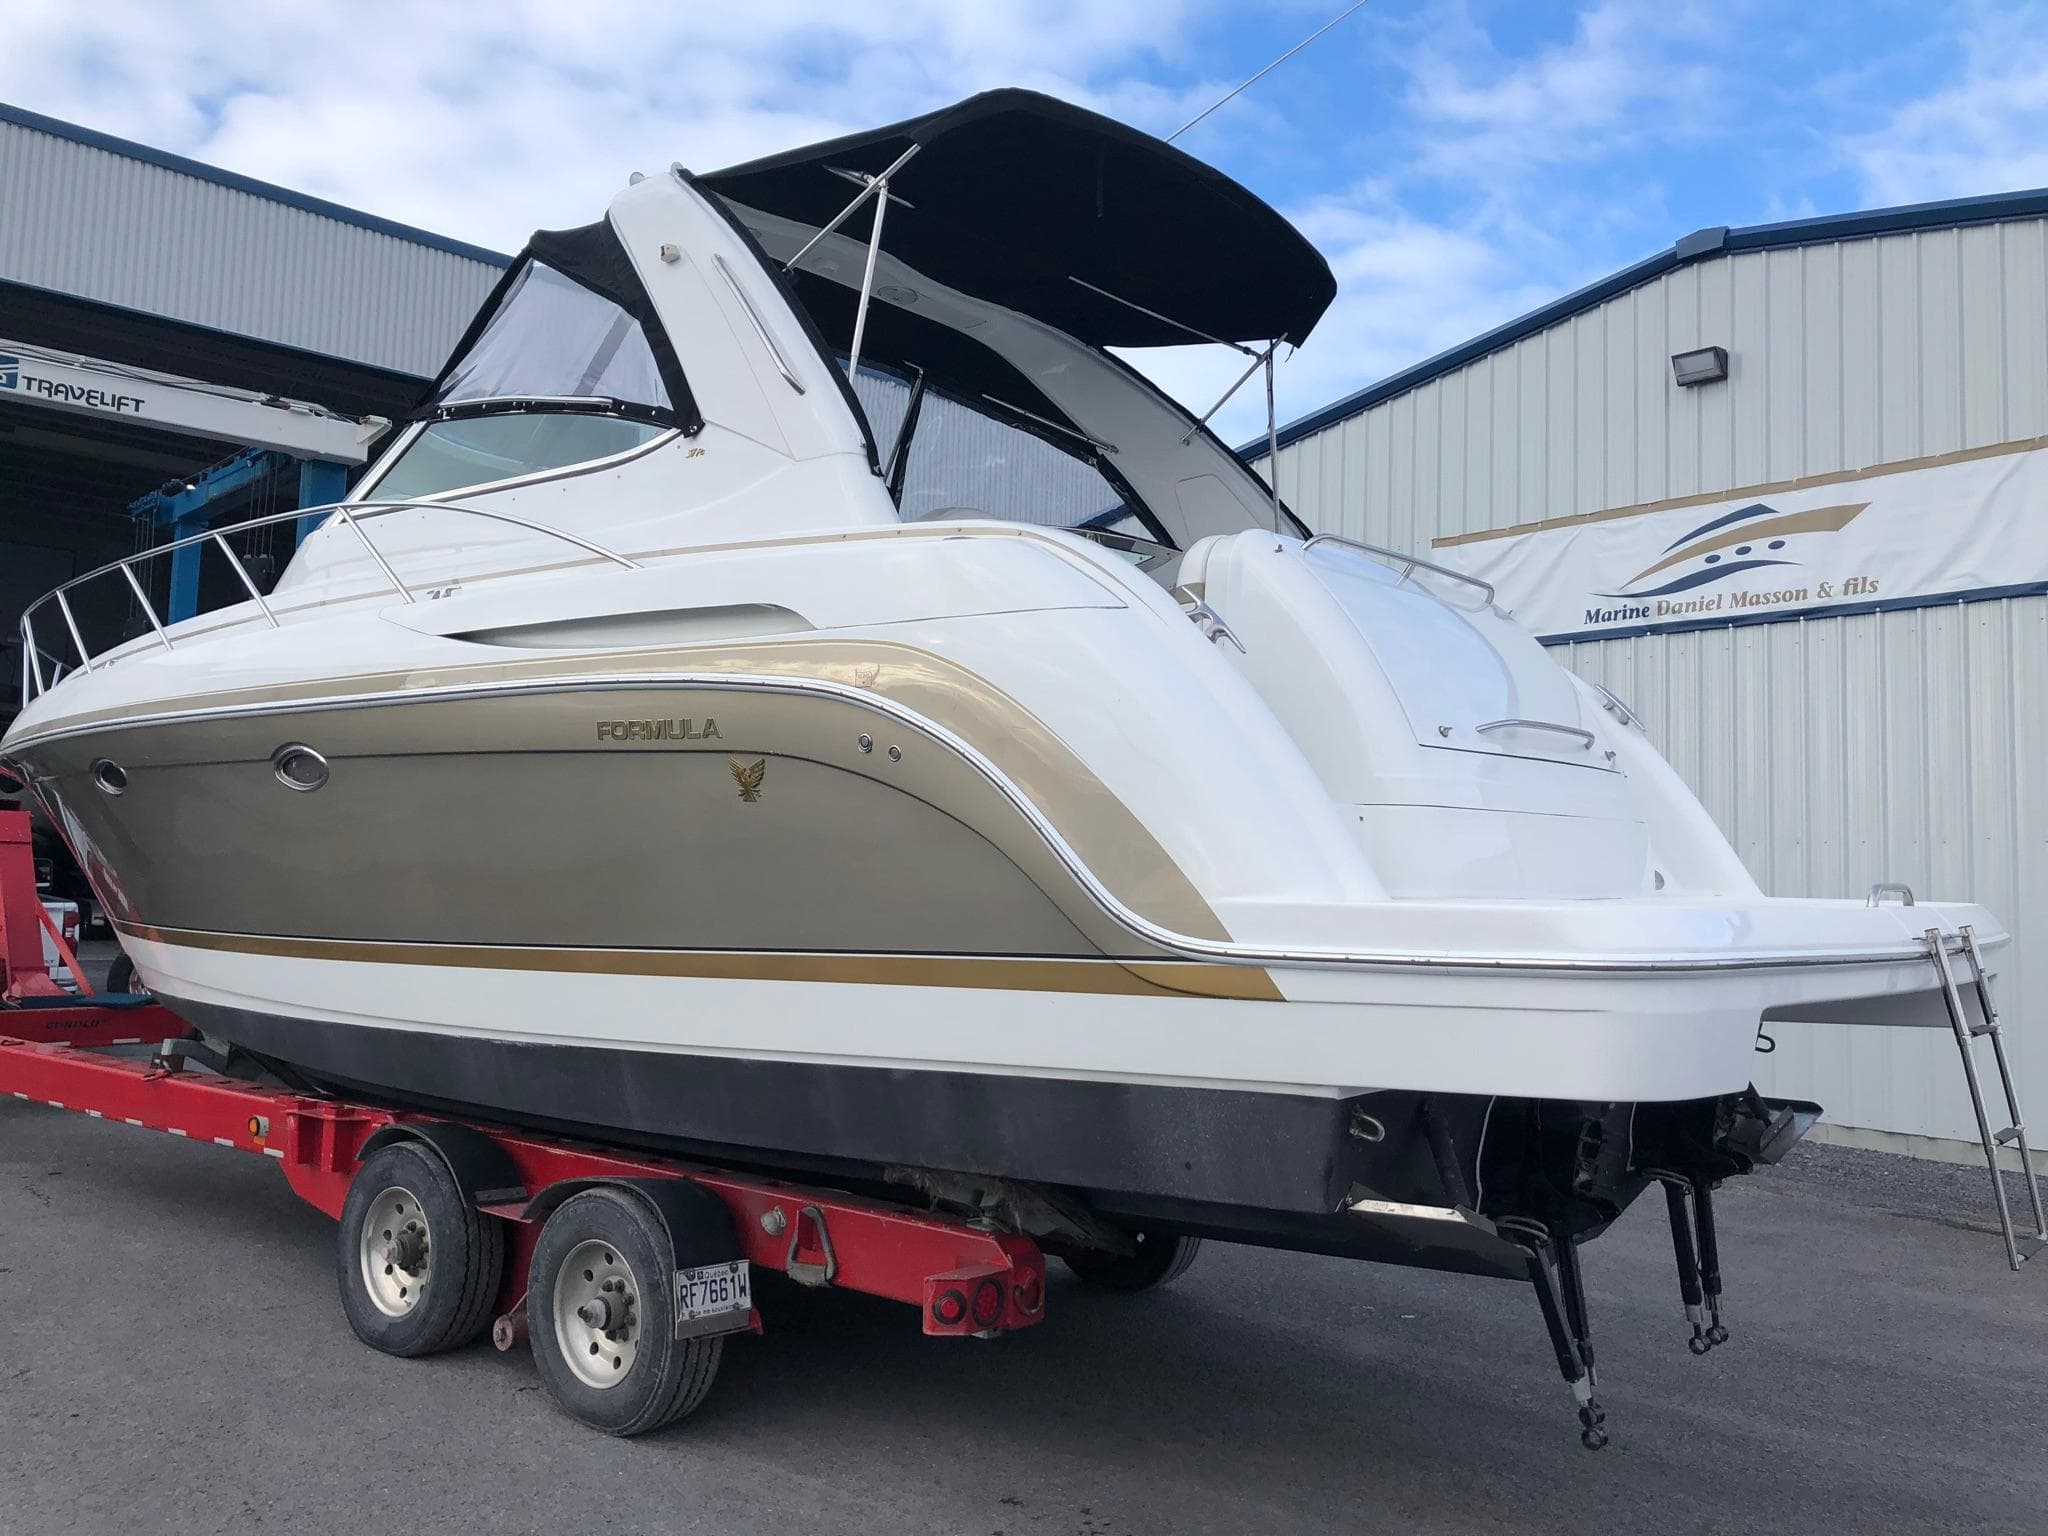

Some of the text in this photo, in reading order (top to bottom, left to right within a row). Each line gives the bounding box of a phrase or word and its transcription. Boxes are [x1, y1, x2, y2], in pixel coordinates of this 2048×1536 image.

[21, 375, 145, 412] TRAVELIFT
[1583, 576, 1879, 625] Marine Daniel Masson & fils
[596, 718, 723, 740] FORMULA
[680, 1273, 747, 1308] RF7661W
[704, 1269, 729, 1279] Québec
